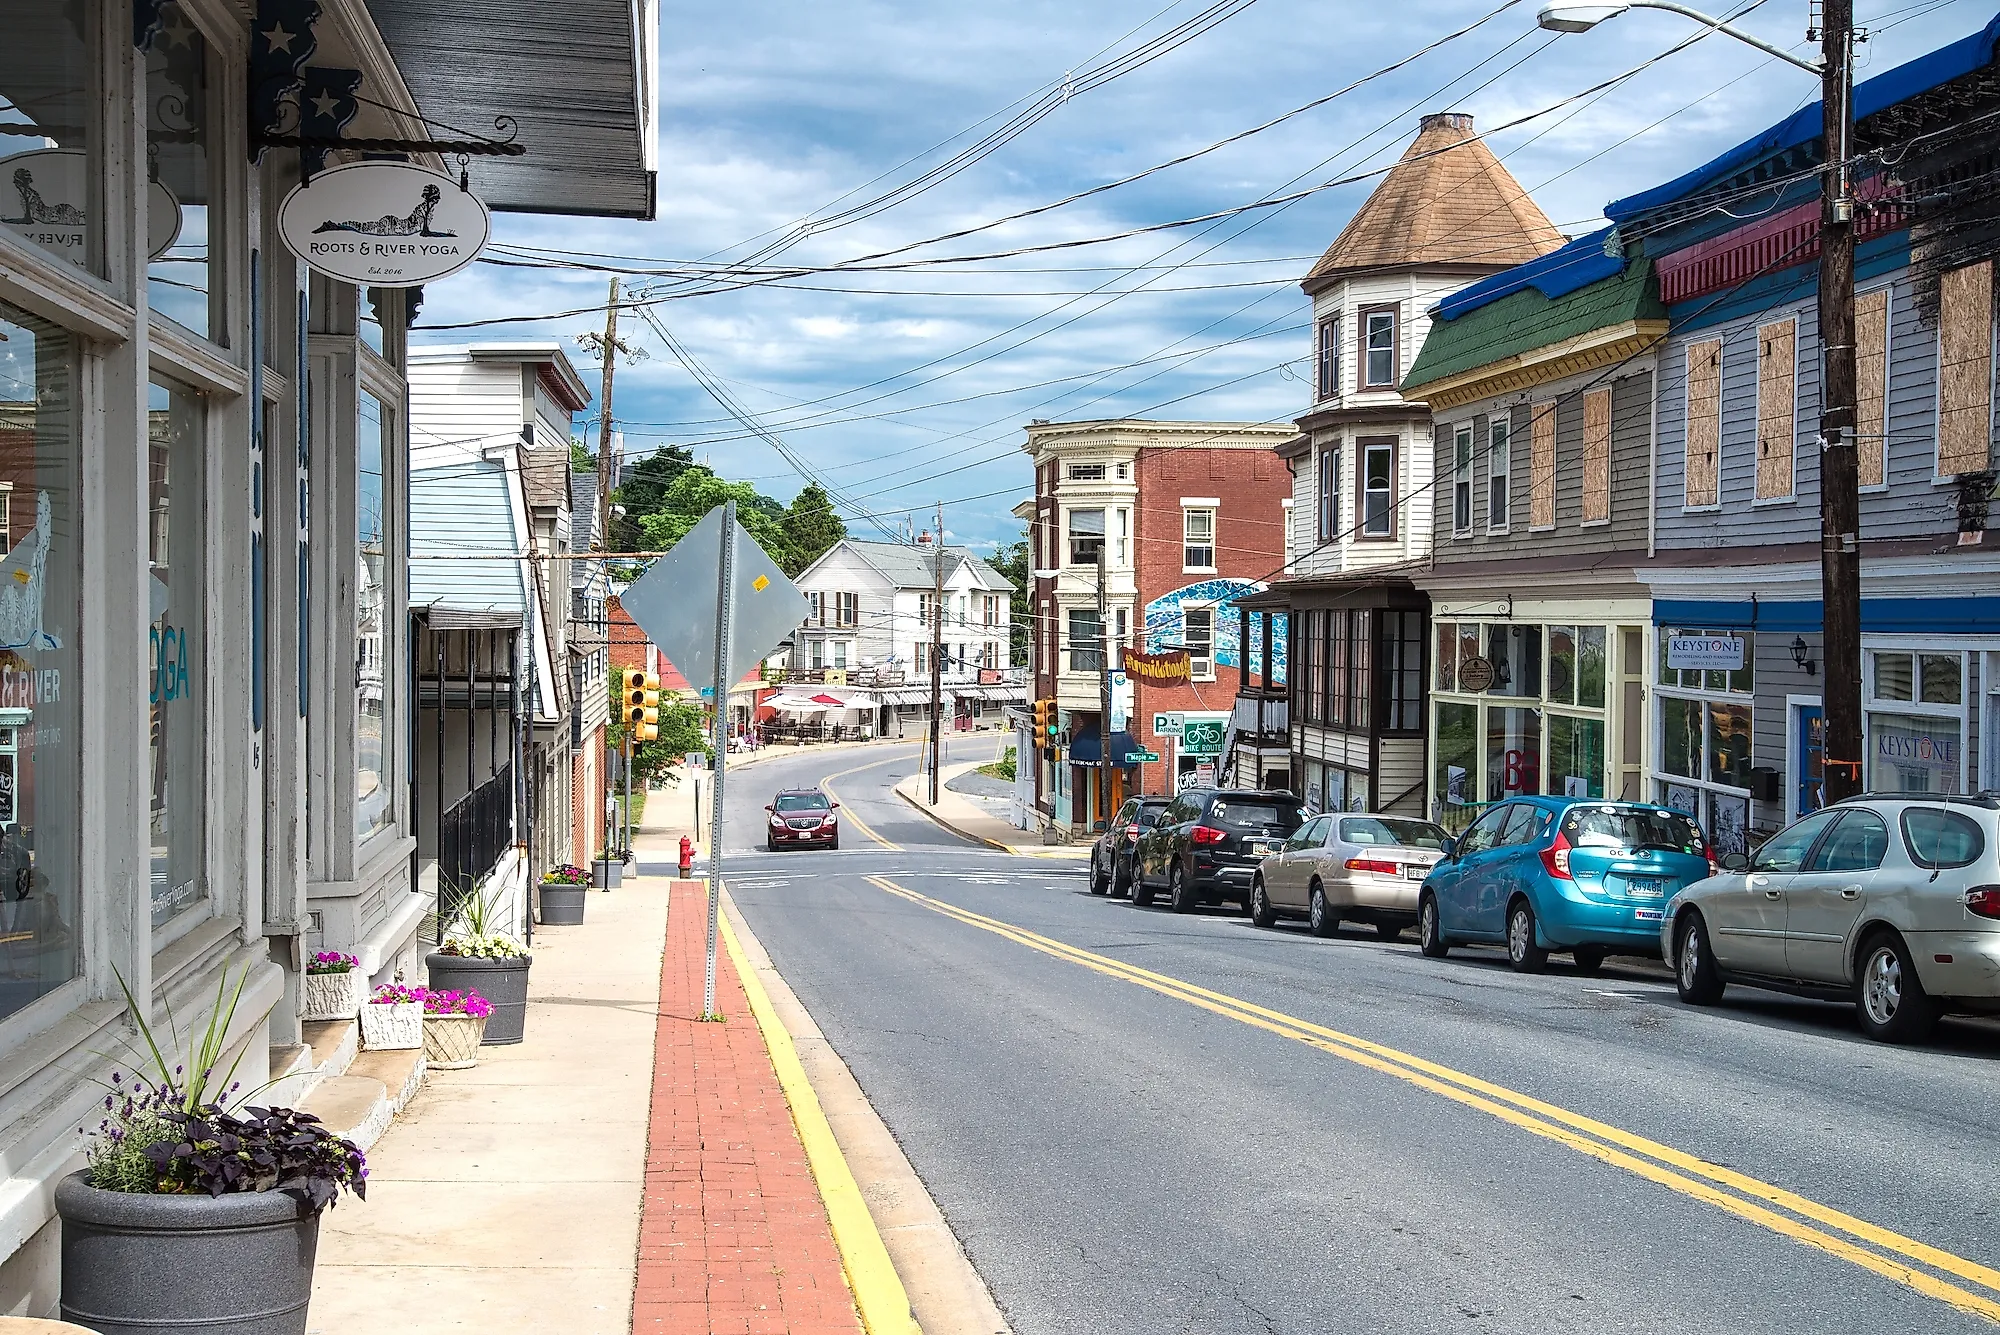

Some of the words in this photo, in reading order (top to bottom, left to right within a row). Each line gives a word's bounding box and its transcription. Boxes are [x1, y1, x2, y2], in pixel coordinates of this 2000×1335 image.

[310, 242, 355, 256] ROOTS
[359, 241, 370, 256] &
[375, 244, 416, 257] RIVER
[419, 244, 460, 256] YOGA
[367, 266, 382, 275] Est.
[384, 267, 403, 275] 2016
[1673, 640, 1740, 652] KEYSTONE
[19, 669, 60, 707] RIVER
[1155, 716, 1183, 733] PARKING
[1185, 744, 1200, 752] BIKE
[1201, 744, 1222, 752] ROUTE
[1879, 735, 1952, 761] KEYSTONE
